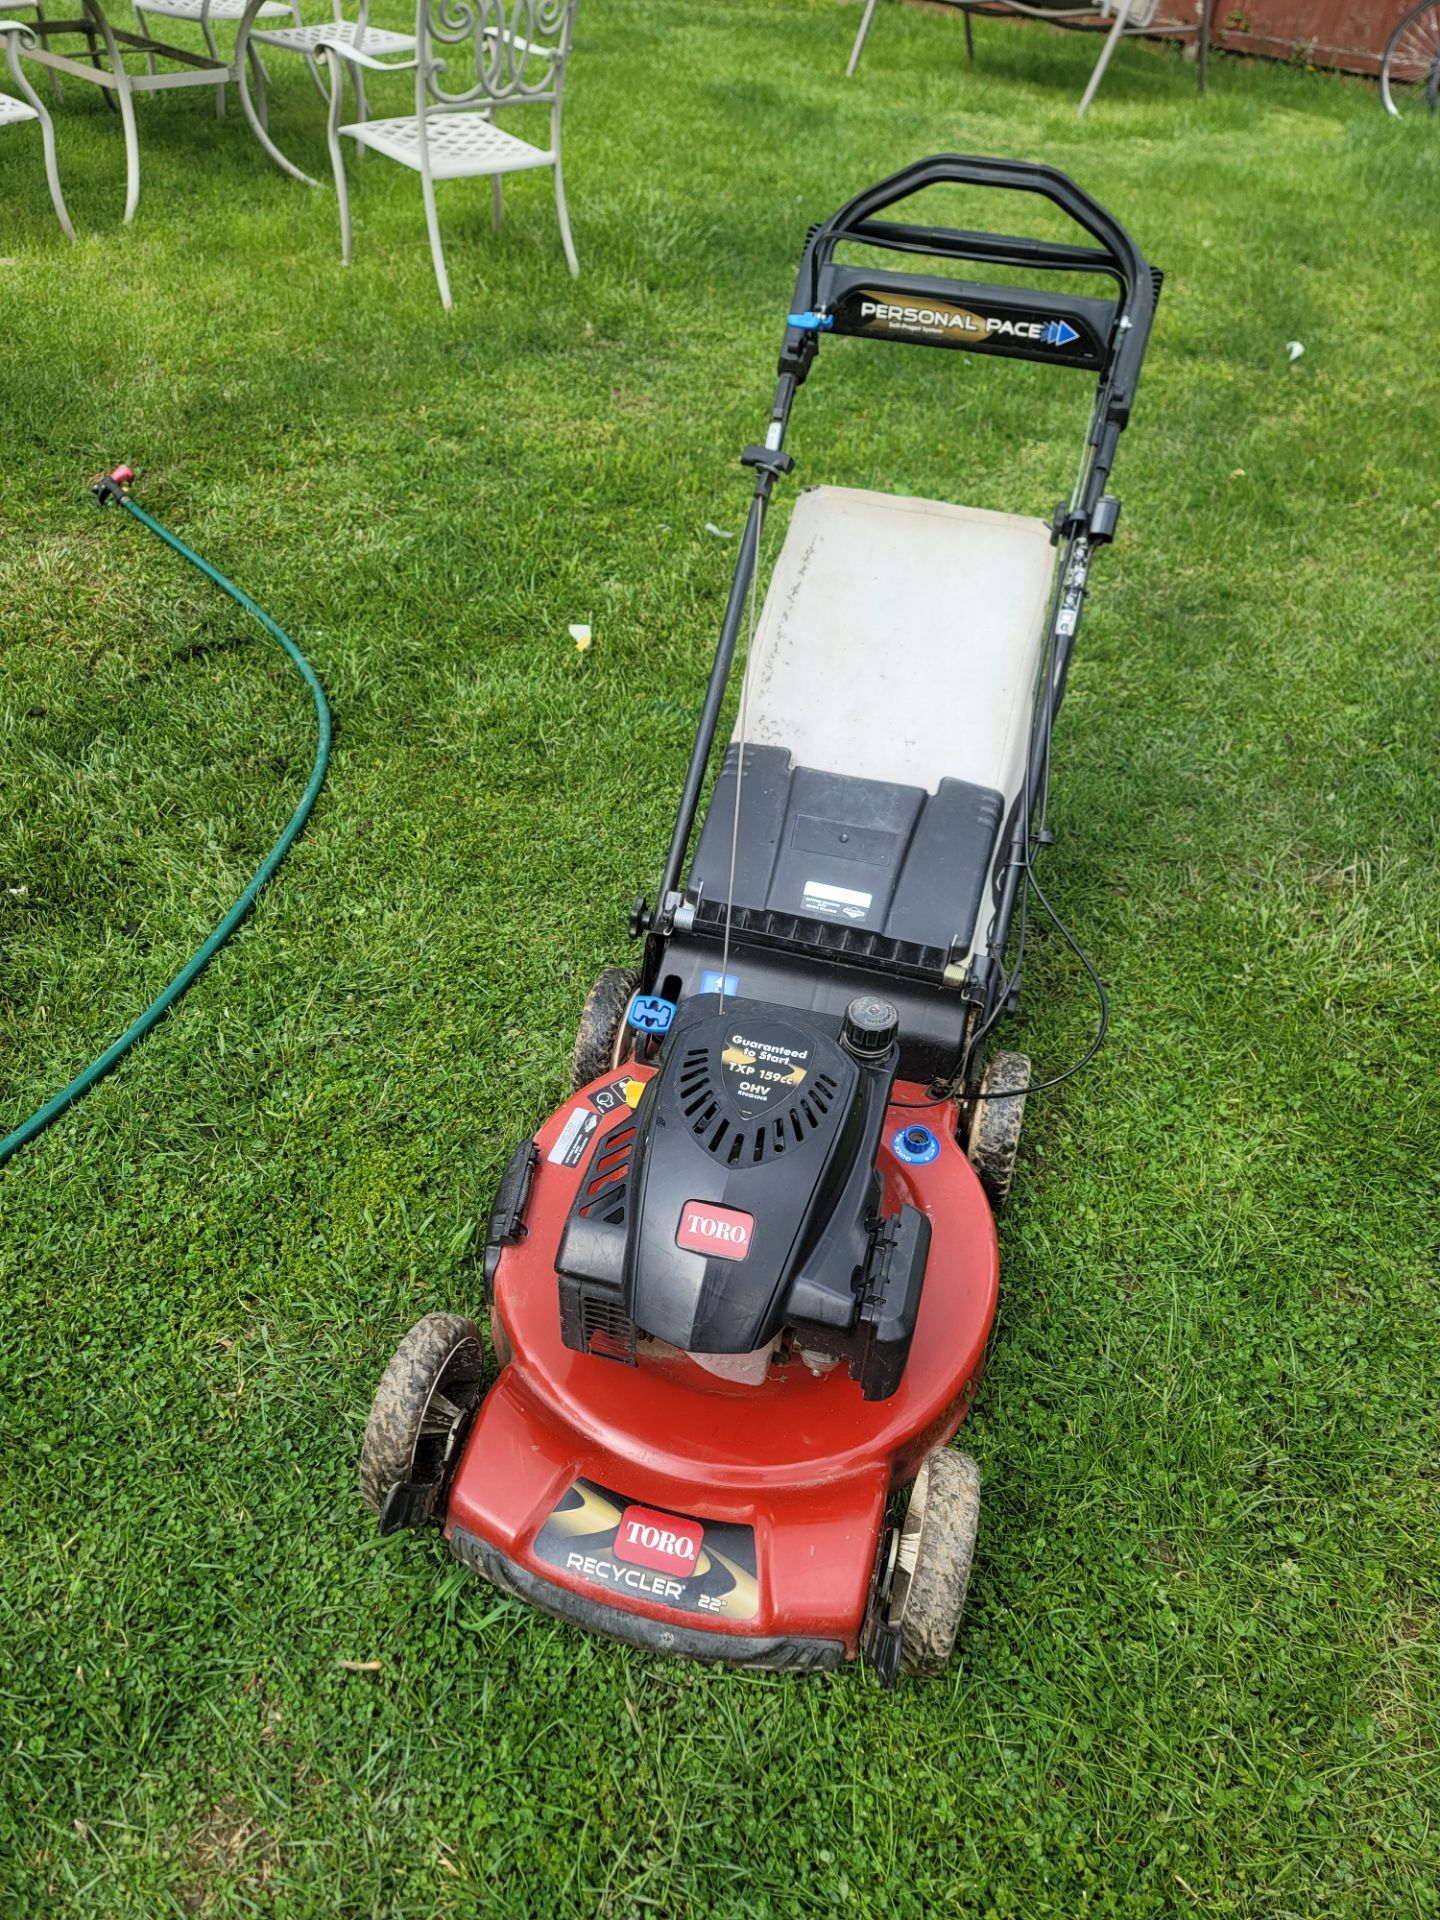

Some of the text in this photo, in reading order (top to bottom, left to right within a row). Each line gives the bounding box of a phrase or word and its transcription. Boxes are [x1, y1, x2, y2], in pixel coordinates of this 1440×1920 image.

[861, 302, 1045, 339] PERSONAL PACE
[732, 1035, 808, 1059] Guaranteed
[743, 1047, 790, 1065] to Start
[729, 1062, 793, 1085] TXP 159cc
[737, 1089, 768, 1101] ENGINE
[739, 1081, 771, 1095] OHV
[687, 1214, 747, 1244] TORO
[626, 1521, 694, 1559] TORO
[566, 1552, 684, 1600] RECYCLER
